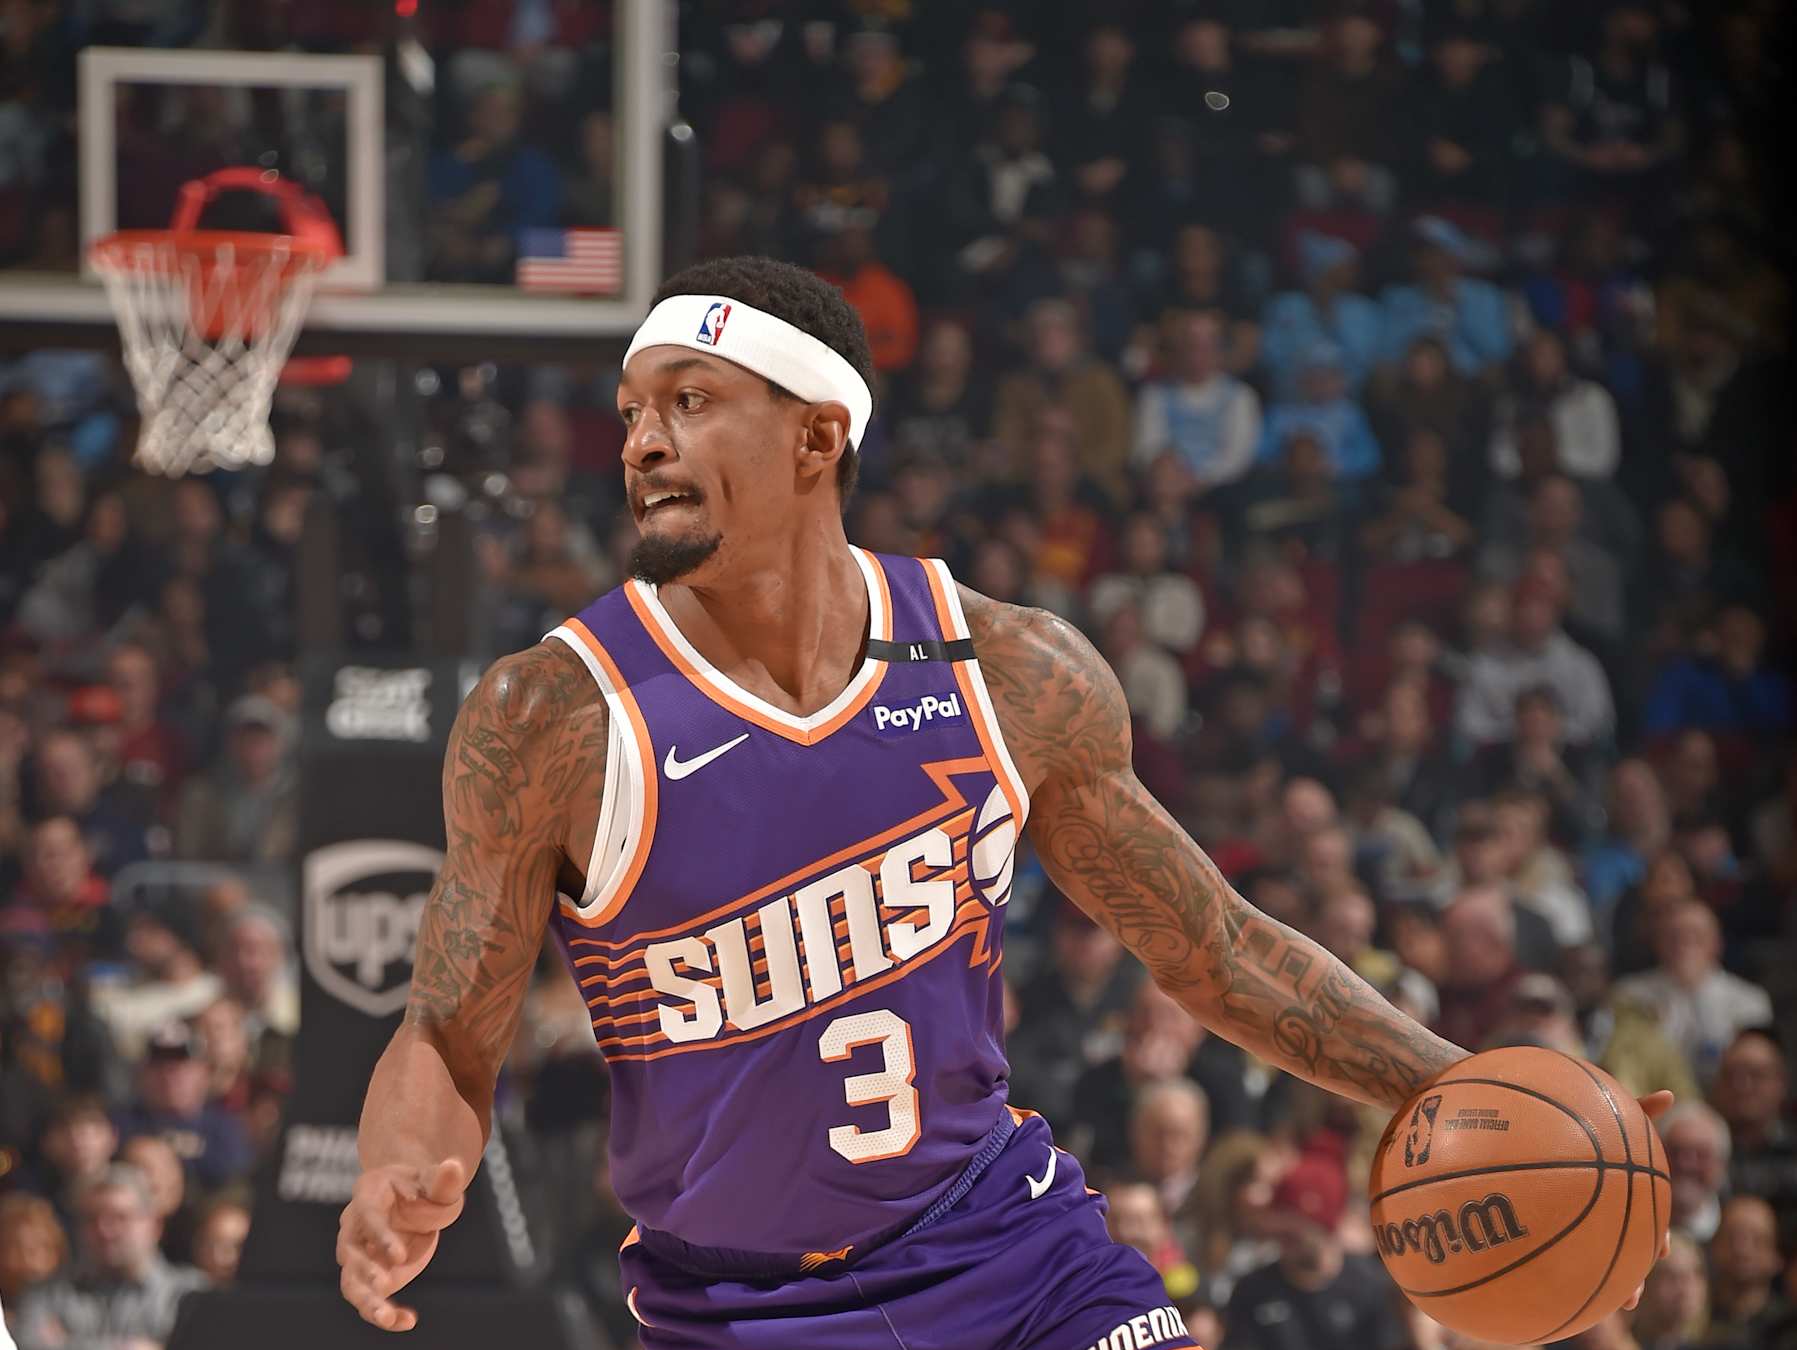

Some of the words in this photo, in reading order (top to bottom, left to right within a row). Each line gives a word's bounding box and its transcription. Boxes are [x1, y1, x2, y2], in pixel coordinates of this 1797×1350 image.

[909, 643, 928, 661] AL
[873, 692, 961, 732] PayPal
[818, 1009, 922, 1165] 3
[1374, 1192, 1530, 1264] Wilson
